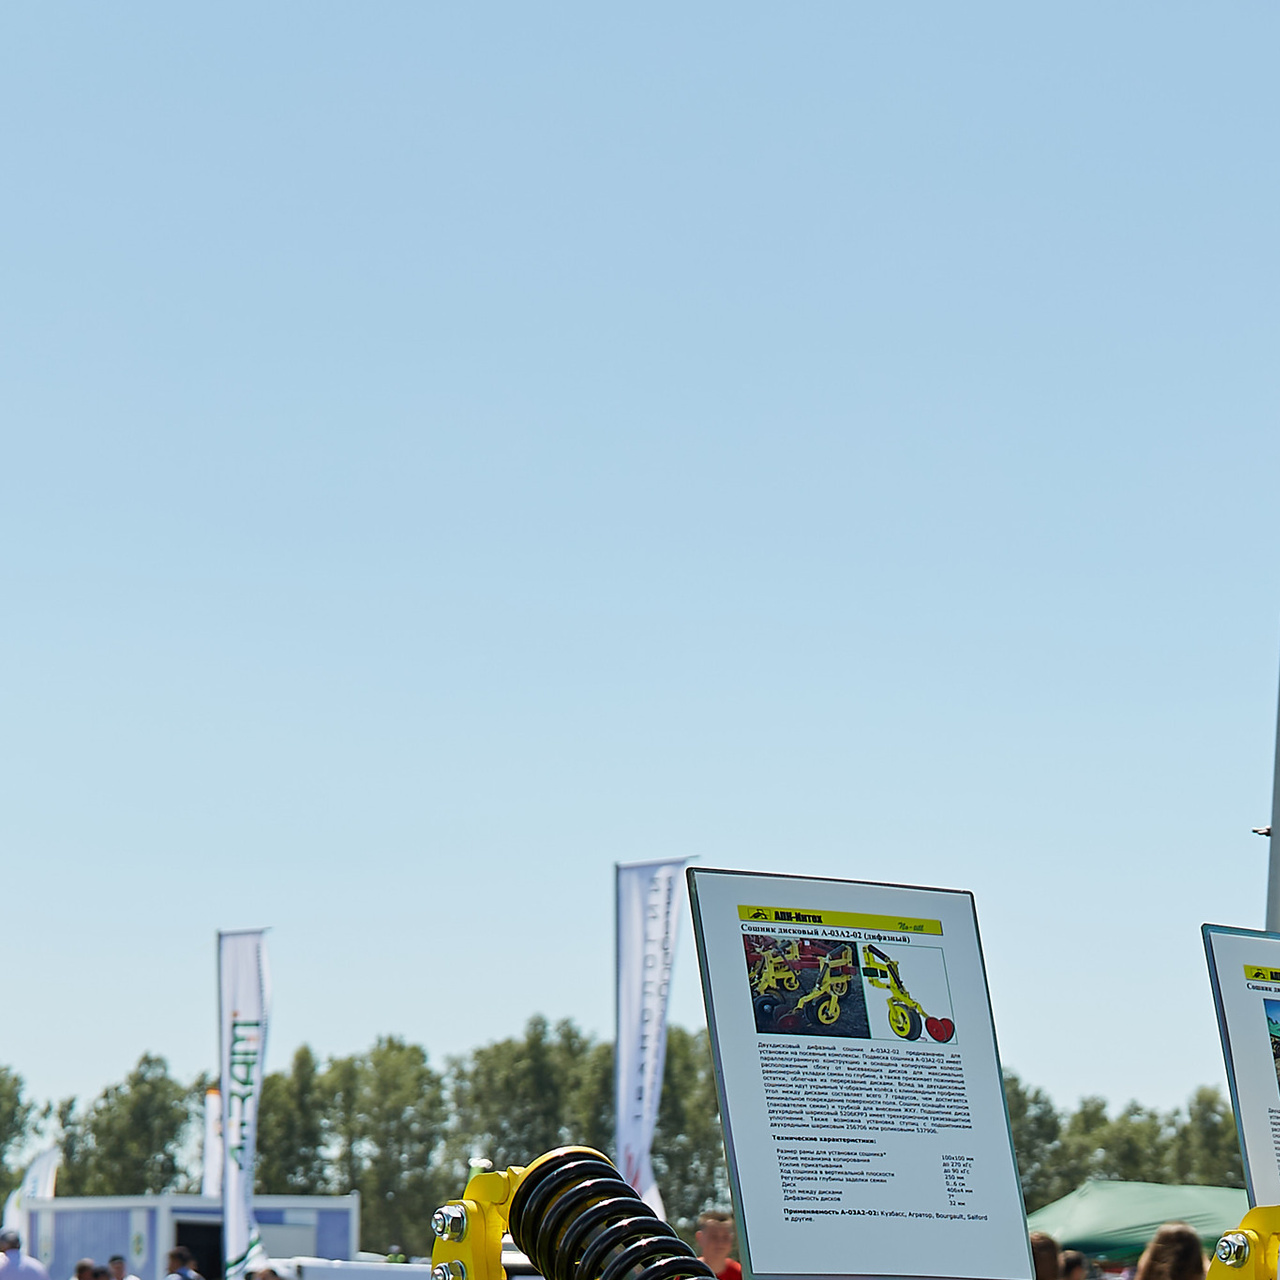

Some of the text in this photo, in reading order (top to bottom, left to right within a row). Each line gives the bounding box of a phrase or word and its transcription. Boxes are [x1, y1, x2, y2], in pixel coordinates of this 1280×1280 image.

[740, 923, 910, 944] Сошник дисковый А-03А2-02 (дифазный)
